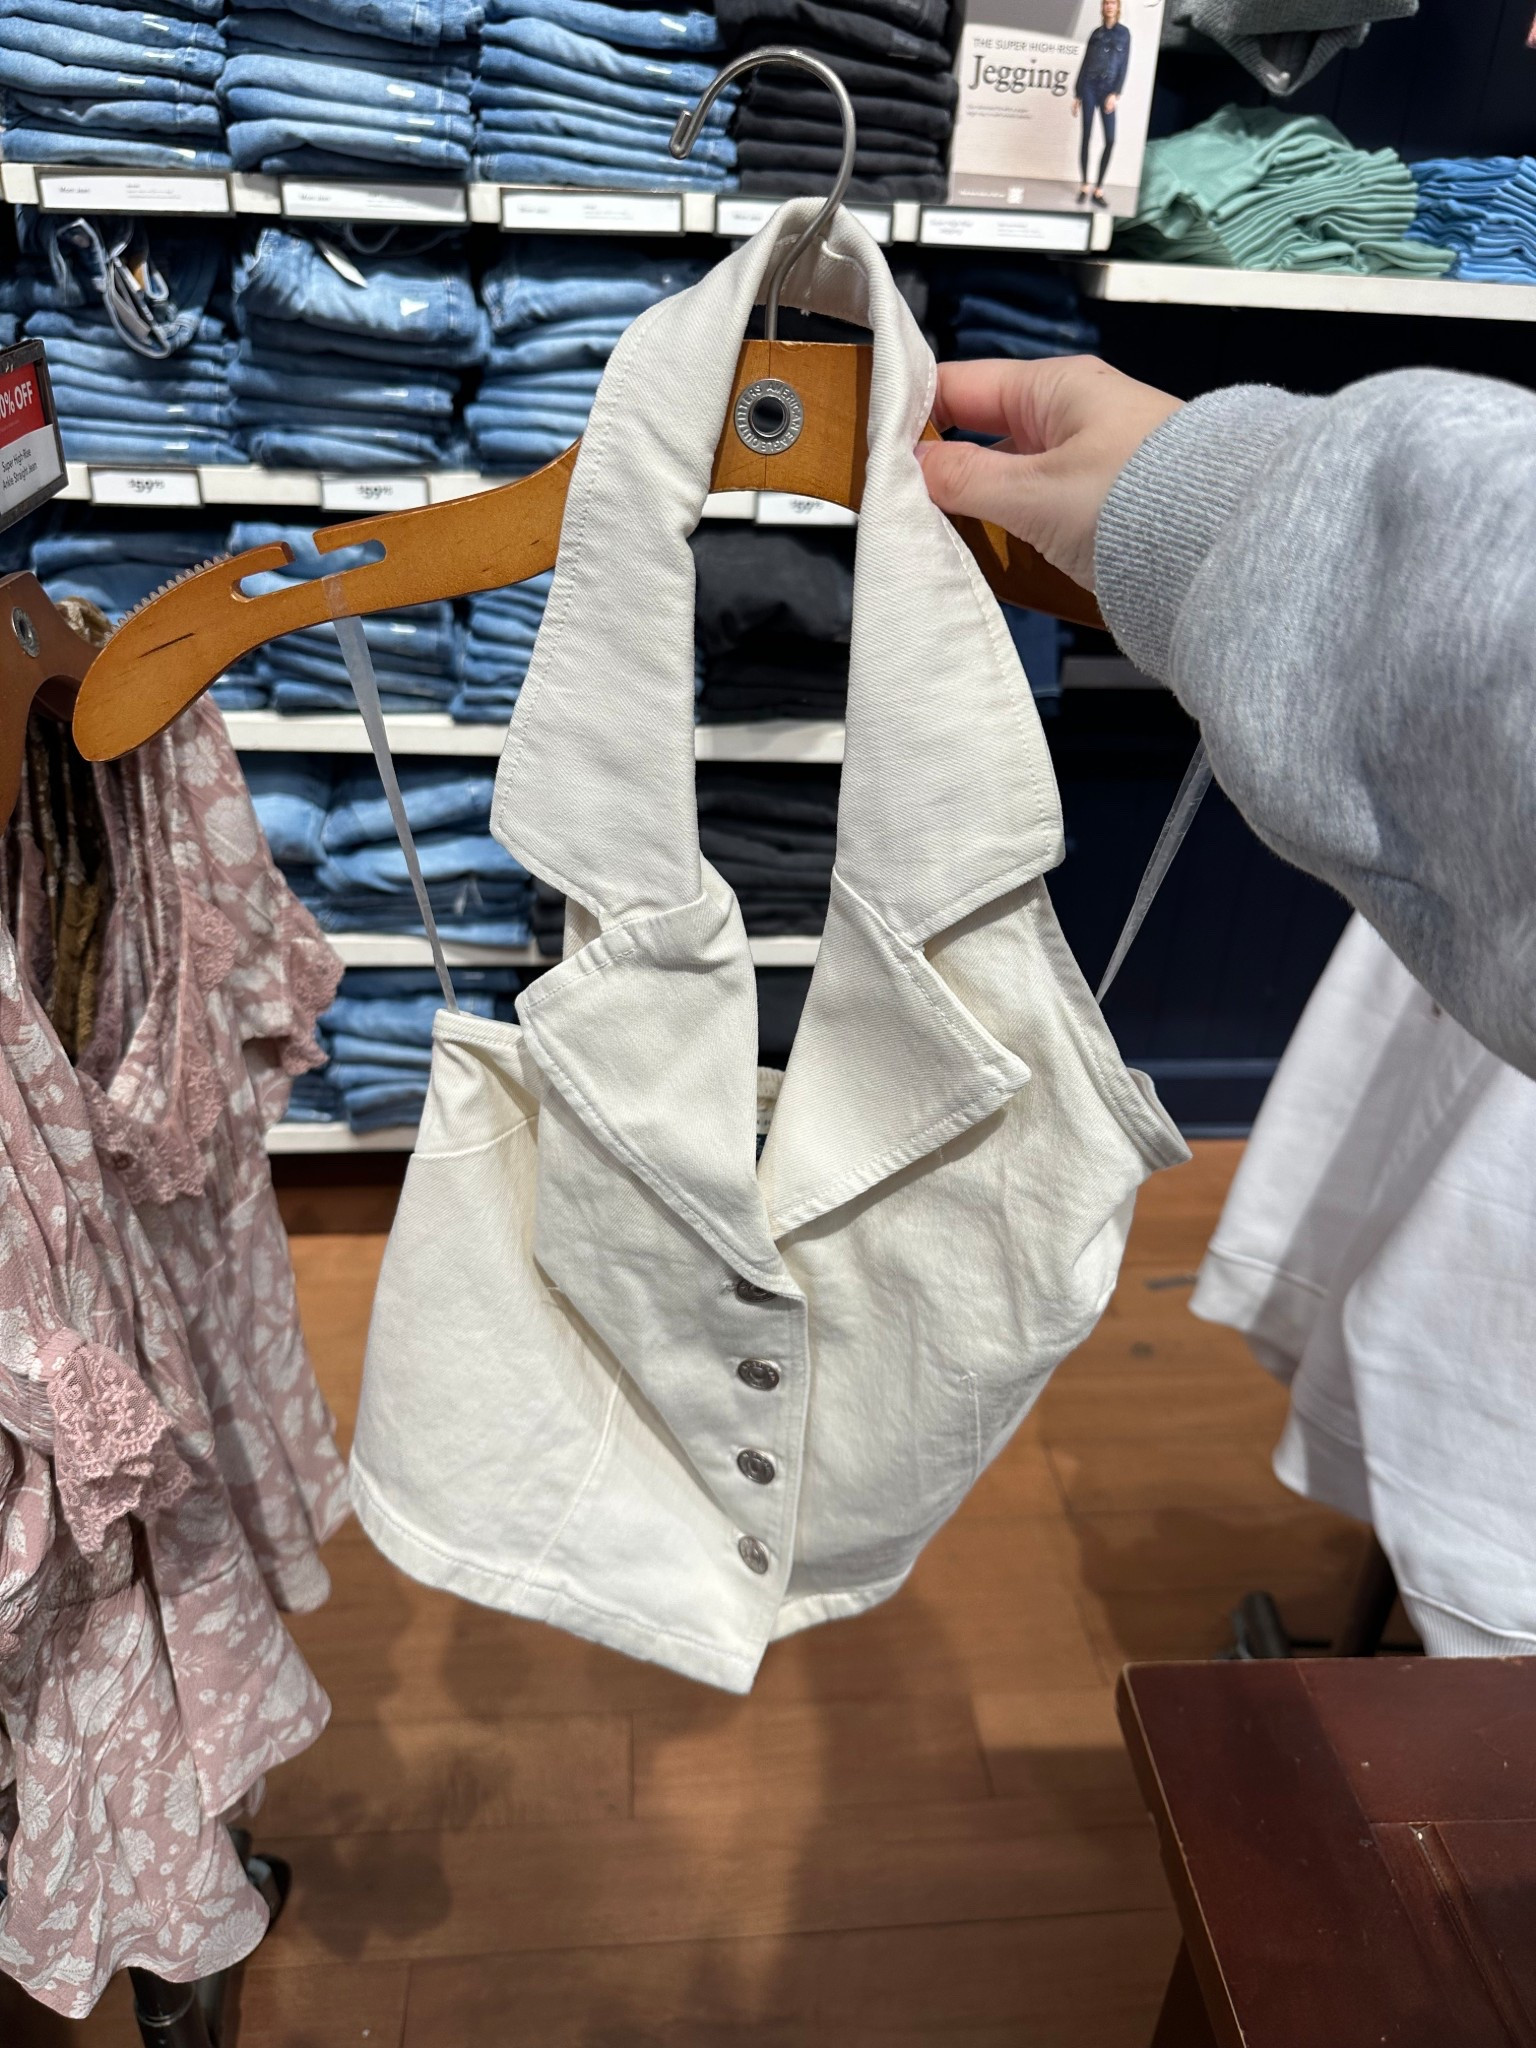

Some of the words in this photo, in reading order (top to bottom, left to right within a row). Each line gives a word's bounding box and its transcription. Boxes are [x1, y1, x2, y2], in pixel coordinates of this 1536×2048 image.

[973, 37, 994, 49] THE
[995, 39, 1027, 51] SUPER
[1029, 42, 1079, 56] HIGH-RISE
[968, 54, 1070, 97] Jegging
[0, 389, 16, 420] 0%
[14, 380, 34, 410] OFF
